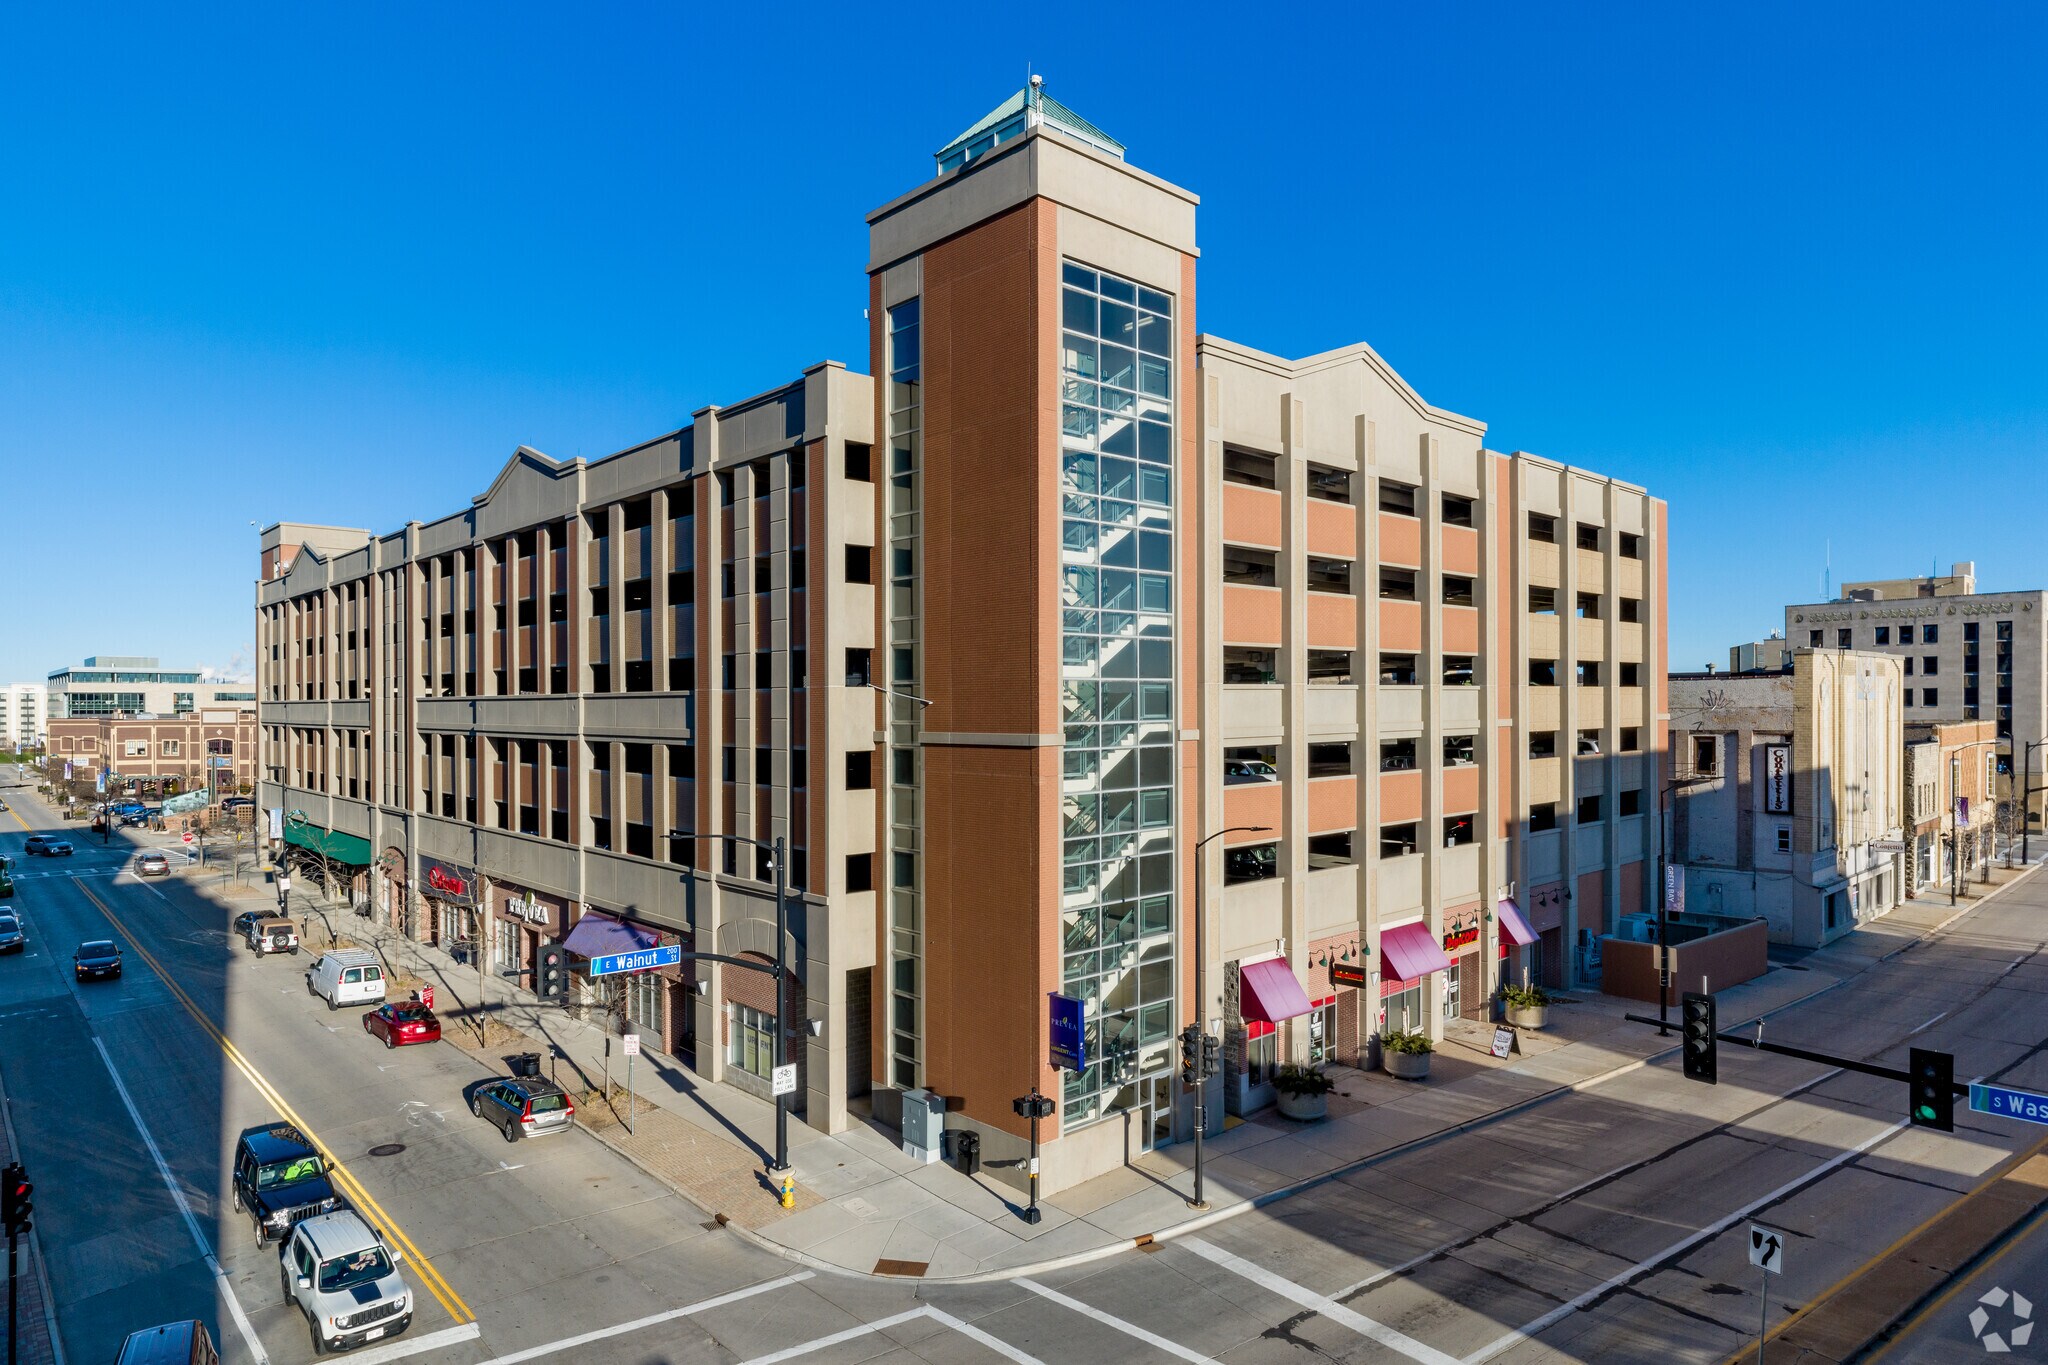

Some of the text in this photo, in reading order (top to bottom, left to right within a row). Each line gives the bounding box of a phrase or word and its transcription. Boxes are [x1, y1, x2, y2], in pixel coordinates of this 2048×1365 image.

[1667, 866, 1675, 903] GREEN BAY
[666, 947, 678, 955] 200
[605, 950, 658, 970] E Walnut
[1051, 1017, 1077, 1031] PREVEA
[1051, 1045, 1070, 1055] URGENT
[1994, 1096, 2002, 1108] S
